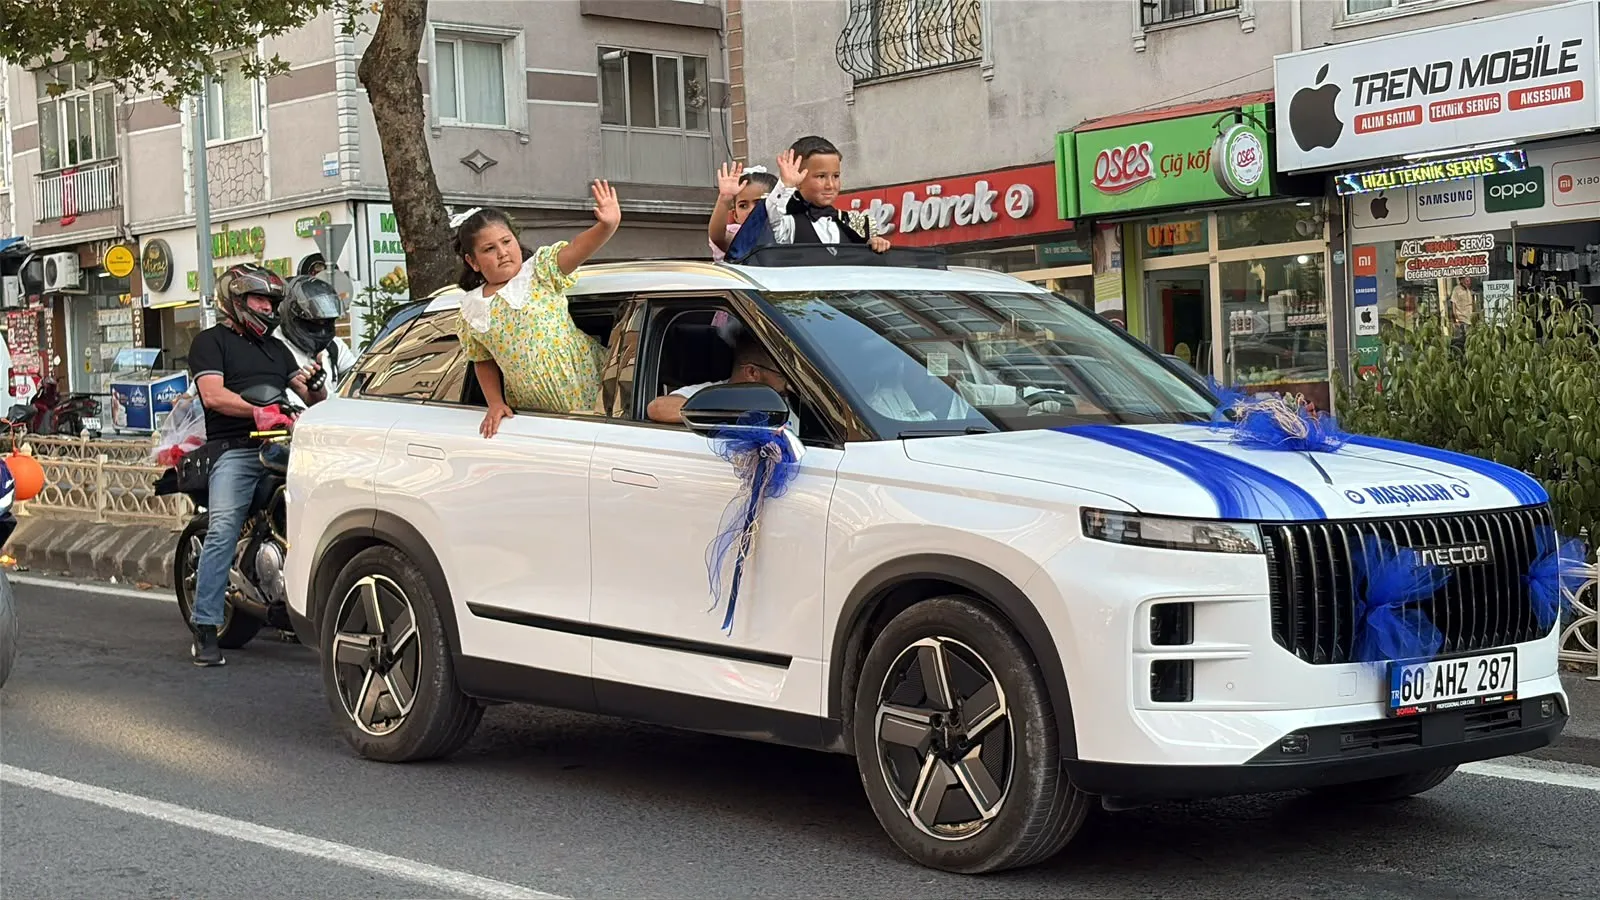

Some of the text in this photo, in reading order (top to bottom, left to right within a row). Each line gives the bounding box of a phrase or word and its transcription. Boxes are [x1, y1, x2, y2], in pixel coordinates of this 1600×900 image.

[1352, 35, 1583, 107] TREND MOBİLE
[1519, 85, 1572, 106] AKSESUAR
[1361, 109, 1416, 130] ALIM SATIM
[1159, 153, 1183, 178] Çiğ
[1361, 171, 1395, 189] HIZLI
[1489, 180, 1538, 199] oppo
[899, 180, 998, 234] börek
[1010, 189, 1023, 212] 2
[1418, 189, 1473, 206] SAMSUNG
[1459, 233, 1494, 251] SERVİS
[1487, 283, 1509, 291] TELEFON
[1365, 483, 1455, 507] MAŞALLAH
[1401, 656, 1511, 702] 60 AHZ 287
[1391, 690, 1400, 699] TR
